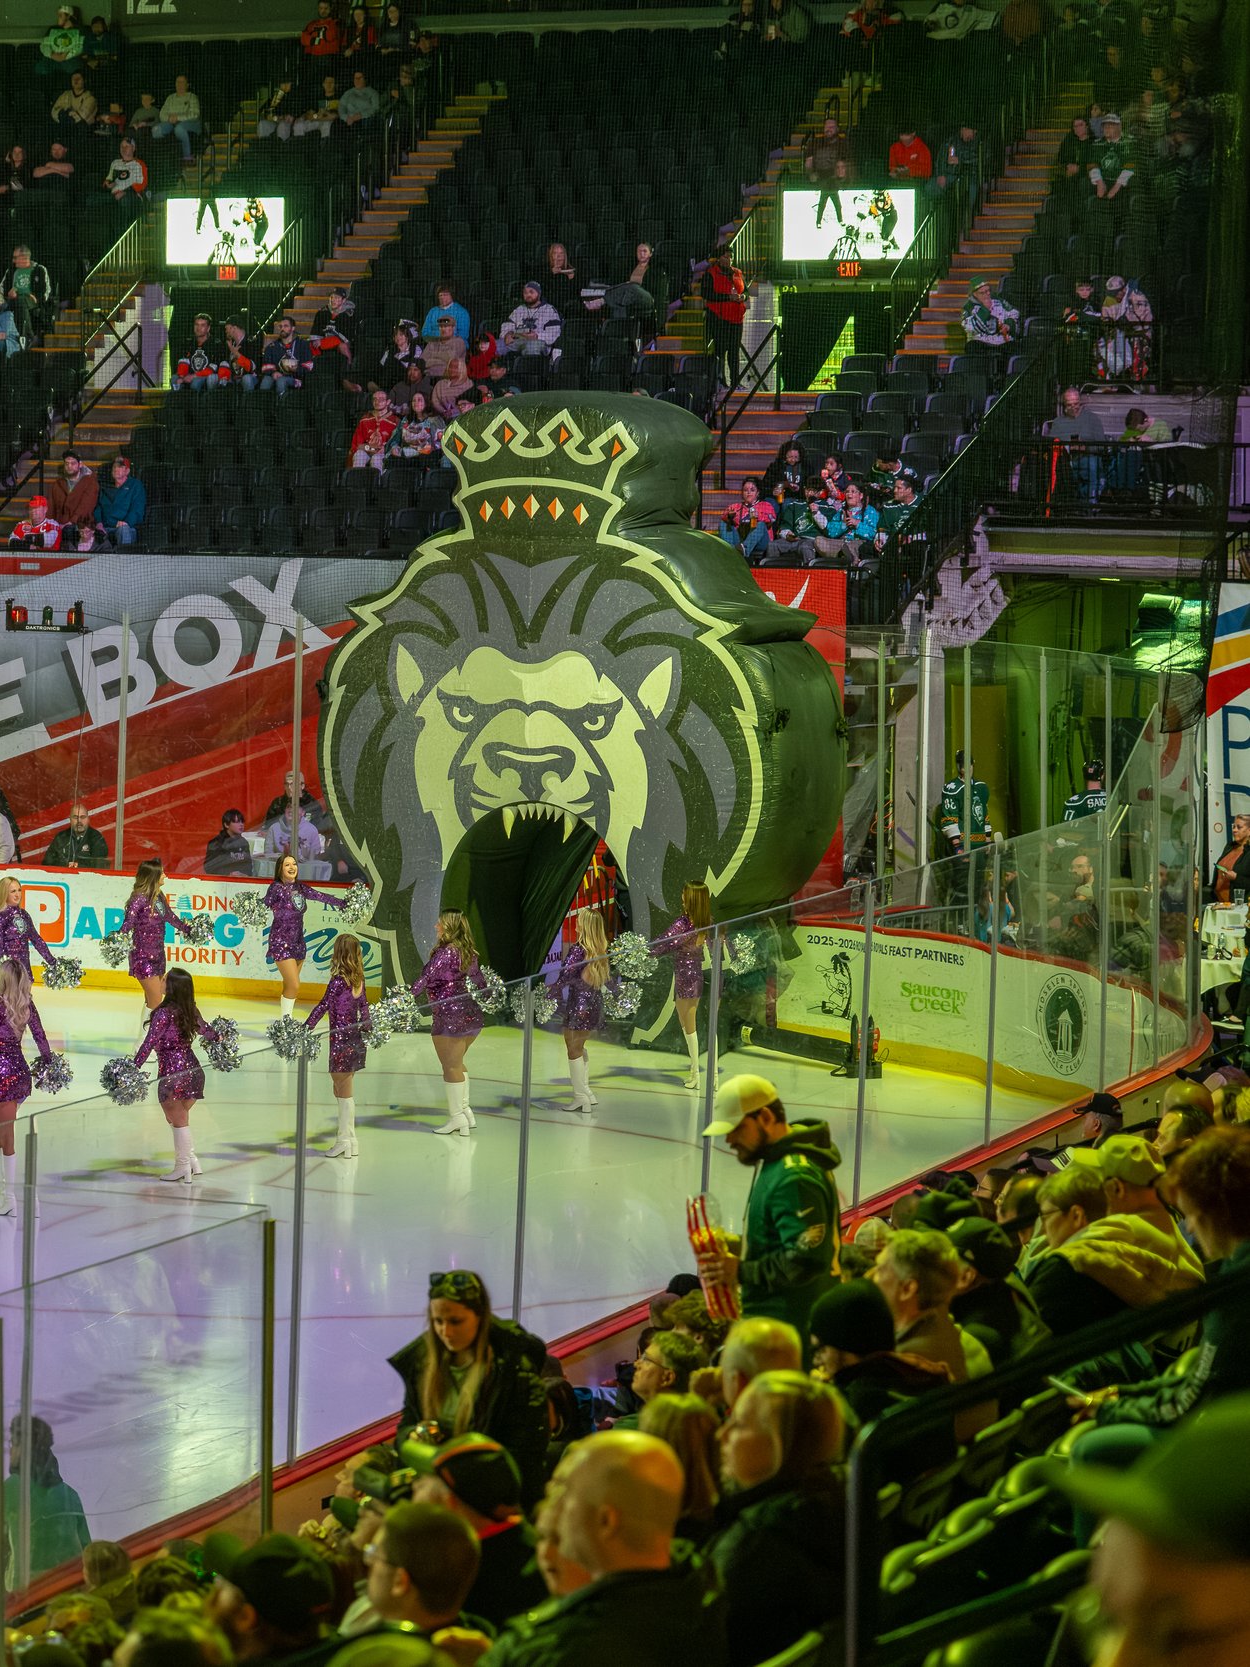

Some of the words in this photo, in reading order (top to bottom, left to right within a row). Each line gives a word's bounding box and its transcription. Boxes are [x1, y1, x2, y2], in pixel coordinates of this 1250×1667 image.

[839, 262, 859, 276] EXIT
[66, 558, 333, 727] BOX
[1064, 810, 1076, 821] 17
[888, 945, 912, 958] FEAST
[913, 948, 965, 966] PARTNERS
[900, 982, 968, 1007] Saucony
[910, 996, 961, 1015] Creek
